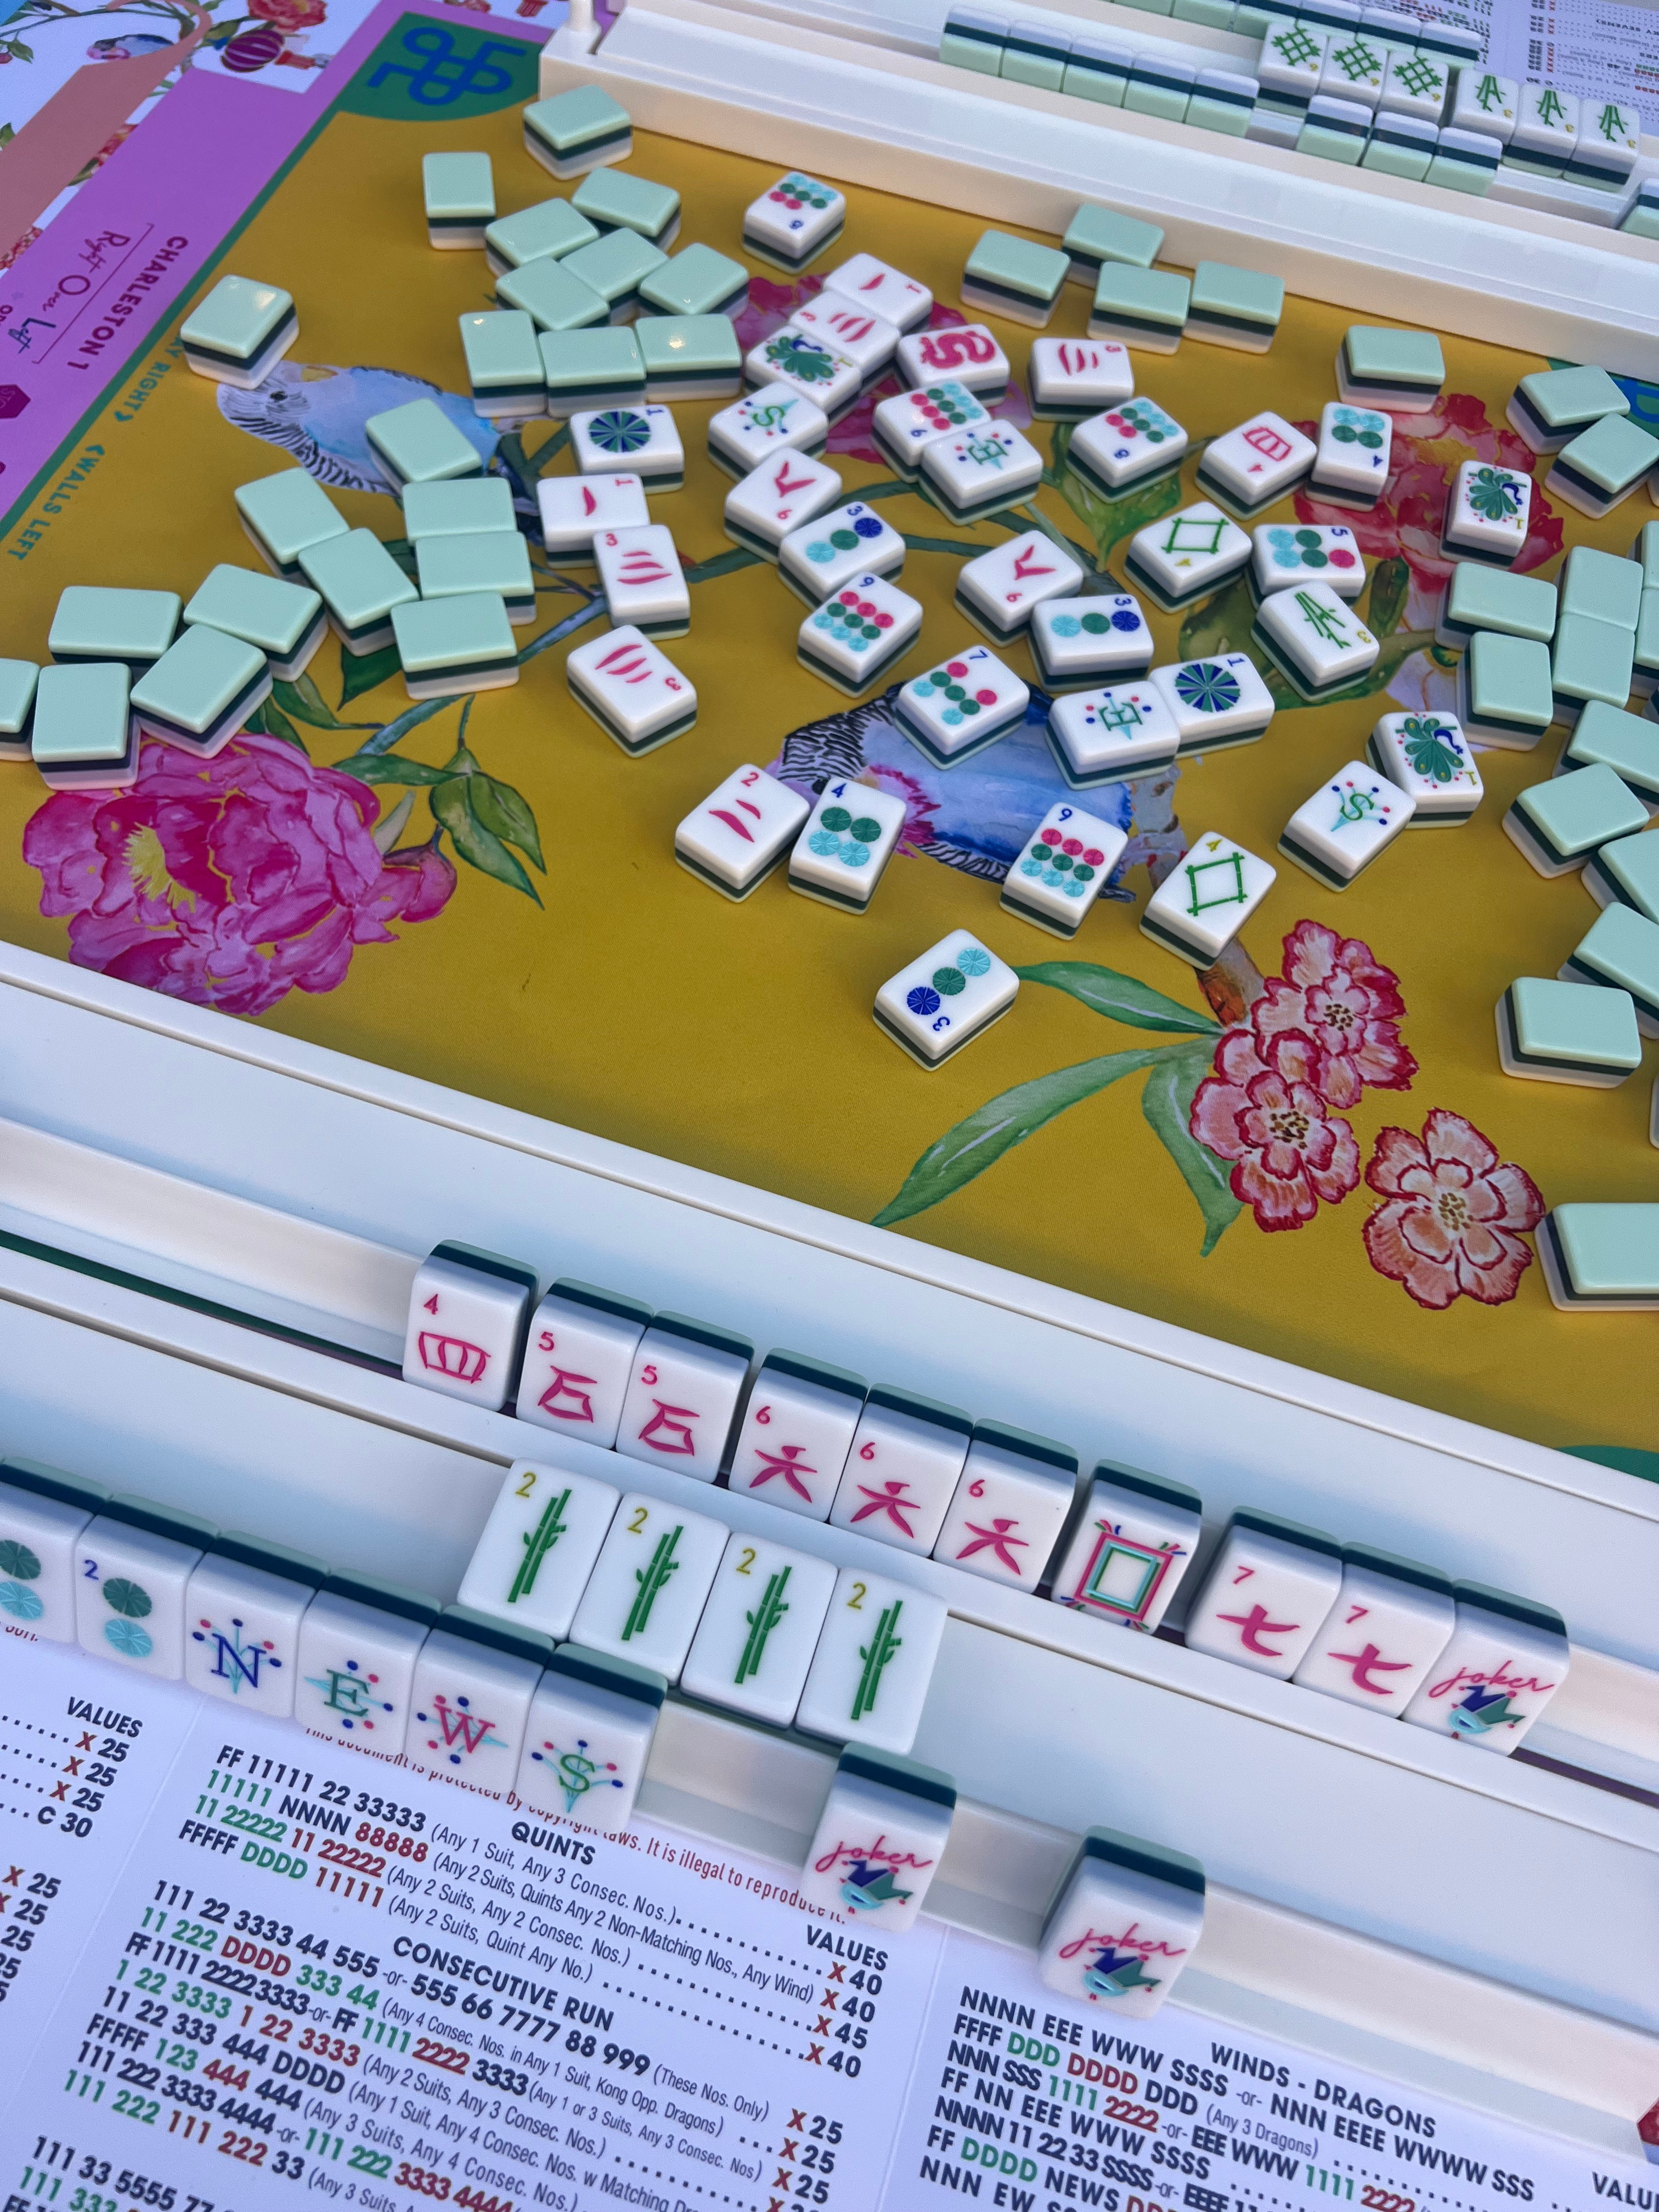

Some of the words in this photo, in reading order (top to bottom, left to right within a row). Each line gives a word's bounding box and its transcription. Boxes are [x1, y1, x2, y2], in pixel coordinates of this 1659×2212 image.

[78, 235, 189, 356] CHARLESTON
[123, 361, 172, 413] RIGHT
[42, 455, 101, 515] WALLS
[847, 506, 862, 516] 3
[8, 517, 52, 561] LEFT
[606, 533, 618, 546] 3
[969, 650, 988, 659] 7
[1227, 658, 1244, 667] 1
[664, 677, 681, 691] 3
[741, 772, 759, 787] 2
[832, 783, 846, 798] 4
[1059, 808, 1073, 821] 9
[1207, 839, 1222, 851] 4
[933, 1017, 950, 1031] 3
[424, 1294, 438, 1315] 4
[538, 1331, 555, 1351] 5
[641, 1365, 658, 1385] 5
[755, 1406, 771, 1425] 6
[860, 1442, 875, 1460] 6
[515, 1471, 537, 1498] 2
[968, 1479, 985, 1498] 6
[627, 1507, 648, 1534] 2
[84, 1560, 99, 1580] 2
[736, 1548, 756, 1575] 2
[1233, 1566, 1255, 1585] 7
[847, 1582, 866, 1610] 2
[1345, 1605, 1369, 1624] 7
[210, 1633, 267, 1689] N
[326, 1668, 371, 1718] E
[1428, 1660, 1555, 1699] joker
[66, 1695, 143, 1739] VALUES
[433, 1704, 495, 1754] W
[95, 1736, 129, 1763] 25
[83, 1761, 117, 1788] 25
[558, 1752, 596, 1794] S
[71, 1786, 105, 1813] 25
[37, 1805, 56, 1825] C
[58, 1812, 93, 1839] 30
[512, 1822, 595, 1865] QUINTS
[815, 1835, 935, 1873] joker
[217, 1745, 244, 1767] FF
[249, 1754, 313, 1792] 11111
[319, 1781, 350, 1806] 22
[354, 1793, 426, 1832] 33333
[431, 1824, 467, 1852] (Any
[472, 1838, 479, 1853] 1
[485, 1843, 514, 1869] Suit,
[522, 1857, 552, 1882] Any
[555, 1868, 565, 1884] 3
[571, 1873, 628, 1908] Consec.
[849, 1970, 882, 1995] 40
[646, 1837, 660, 1857] It
[662, 1843, 676, 1863] is
[679, 1849, 725, 1881] illegal
[729, 1867, 742, 1887] to
[27, 1872, 61, 1899] 25
[207, 1769, 272, 1807] 11111
[279, 1795, 351, 1836] NNNN
[356, 1822, 428, 1862] 88888
[434, 1853, 467, 1880] (Any
[468, 1865, 480, 1882] 2
[481, 1869, 515, 1898] Suits,
[521, 1883, 563, 1912] Quints
[565, 1900, 593, 1925] Any
[594, 1910, 606, 1927] 2
[608, 1915, 702, 1966] Non-Matching
[705, 1949, 737, 1978] Nos.,
[742, 1964, 771, 1990] Any
[775, 1973, 813, 2004] Wind)
[842, 1996, 875, 2022] 40
[13, 1898, 49, 1925] 25
[1, 1925, 35, 1952] 25
[808, 1925, 888, 1971] VALUES
[1058, 1922, 1187, 1959] joker
[394, 1937, 558, 2011] CONSECUTIVE
[563, 1997, 614, 2031] RUN
[155, 1880, 194, 1910] 111
[199, 1898, 230, 1924] 22
[234, 1910, 293, 1946] 3333
[296, 1934, 329, 1960] 44
[333, 1945, 380, 1978] 555
[411, 1974, 458, 2006] 555
[461, 1993, 493, 2019] 66
[499, 2005, 561, 2042] 7777
[566, 2030, 596, 2057] 88
[603, 2044, 650, 2075] 999
[653, 2064, 697, 2095] (These
[701, 2083, 728, 2107] Nos.
[734, 2096, 769, 2122] Only)
[809, 2115, 843, 2144] 25
[953, 2013, 1002, 2046] FFFF
[1007, 2032, 1060, 2067] DDD
[1067, 2052, 1138, 2094] DDDD
[1145, 2080, 1198, 2115] DDD
[1206, 2104, 1238, 2133] (Any
[1242, 2119, 1251, 2135] 3
[1255, 2123, 1318, 2159] Dragons)
[960, 1986, 1035, 2029] NNNN
[1042, 2014, 1082, 2046] EEE
[1092, 2030, 1164, 2073] WWW
[1170, 2059, 1228, 2096] SSSS
[1271, 2094, 1327, 2131] NNN
[1334, 2115, 1385, 2152] EEEE
[1395, 2135, 1487, 2185] WWWW
[1492, 2170, 1534, 2201] SSS
[1212, 2042, 1289, 2087] WINDS
[1314, 2079, 1435, 2137] DRAGONS
[941, 2067, 968, 2093] FF
[974, 2078, 1013, 2111] NN
[1021, 2095, 1062, 2128] EEE
[1071, 2111, 1145, 2156] WWW
[1151, 2141, 1210, 2180] SSSS
